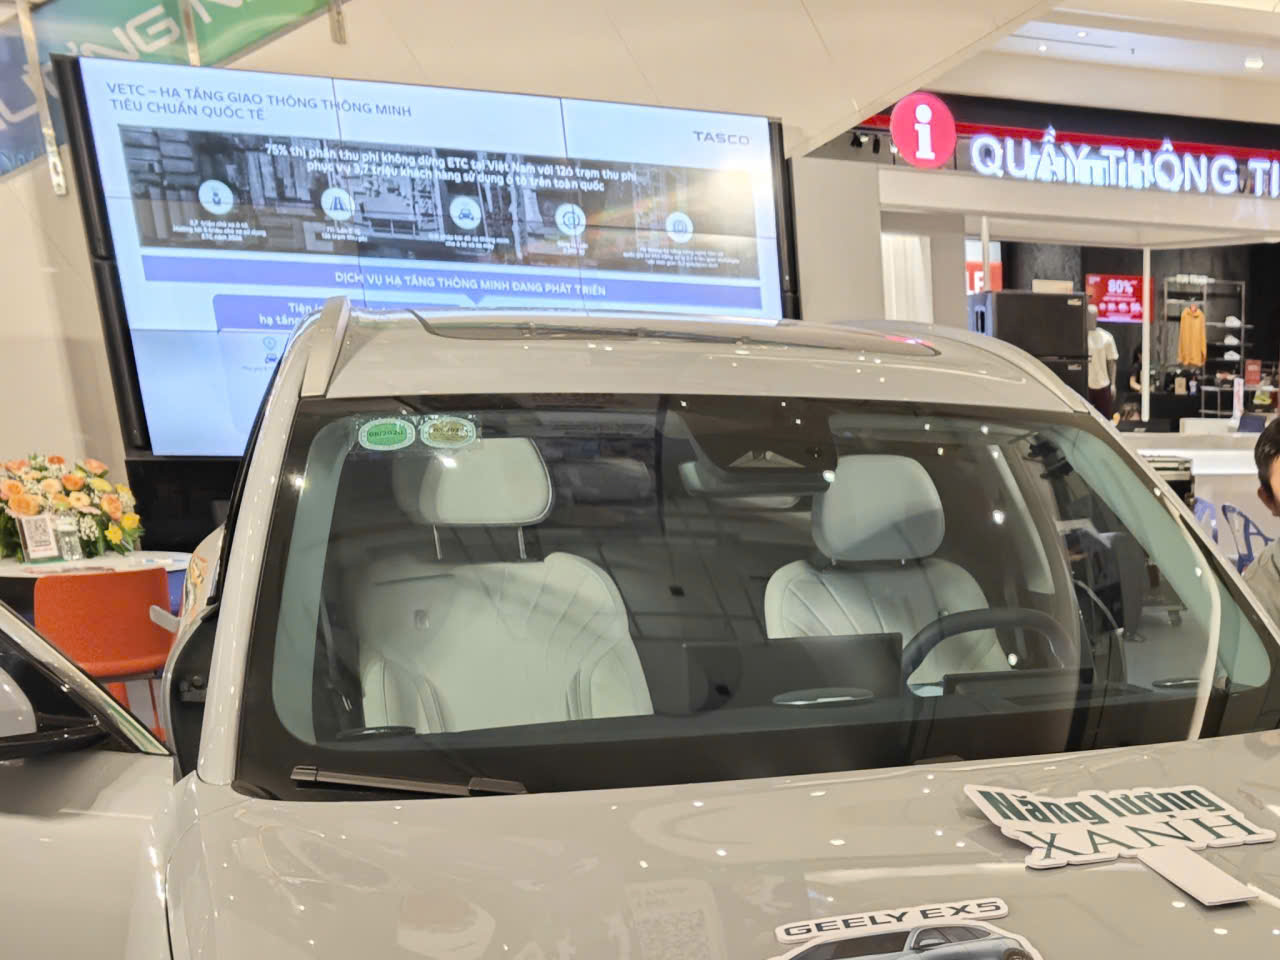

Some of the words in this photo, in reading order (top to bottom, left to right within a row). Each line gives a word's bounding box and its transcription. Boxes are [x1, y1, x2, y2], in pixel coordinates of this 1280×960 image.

[106, 82, 146, 97] VETC
[226, 92, 263, 105] GIAO
[265, 93, 319, 109] THÔNG
[322, 98, 373, 115] THÔNG
[375, 103, 413, 118] MINH
[692, 130, 751, 145] TASCO
[338, 149, 360, 161] thu
[381, 151, 416, 167] không
[417, 154, 446, 169] dừng
[447, 156, 469, 169] ETC
[487, 159, 509, 173] Việt
[512, 162, 536, 174] Nam
[537, 164, 554, 176] với
[602, 169, 620, 180] thu
[372, 165, 398, 178] triệu
[400, 167, 432, 179] khách
[477, 173, 505, 186] dụng
[580, 179, 605, 192] quốc
[1101, 137, 1239, 195] THÔNG
[335, 271, 364, 285] DỊCH
[366, 273, 383, 286] VỤ
[439, 276, 478, 289] THÔNG
[479, 279, 510, 292] MINH
[512, 280, 544, 294] ĐANG
[545, 282, 574, 296] PHÁT
[976, 789, 1106, 826] Năng
[1091, 789, 1226, 819] lượng
[1016, 814, 1259, 860] XANH
[784, 910, 909, 938] GEELY
[919, 900, 1002, 921] EX5
